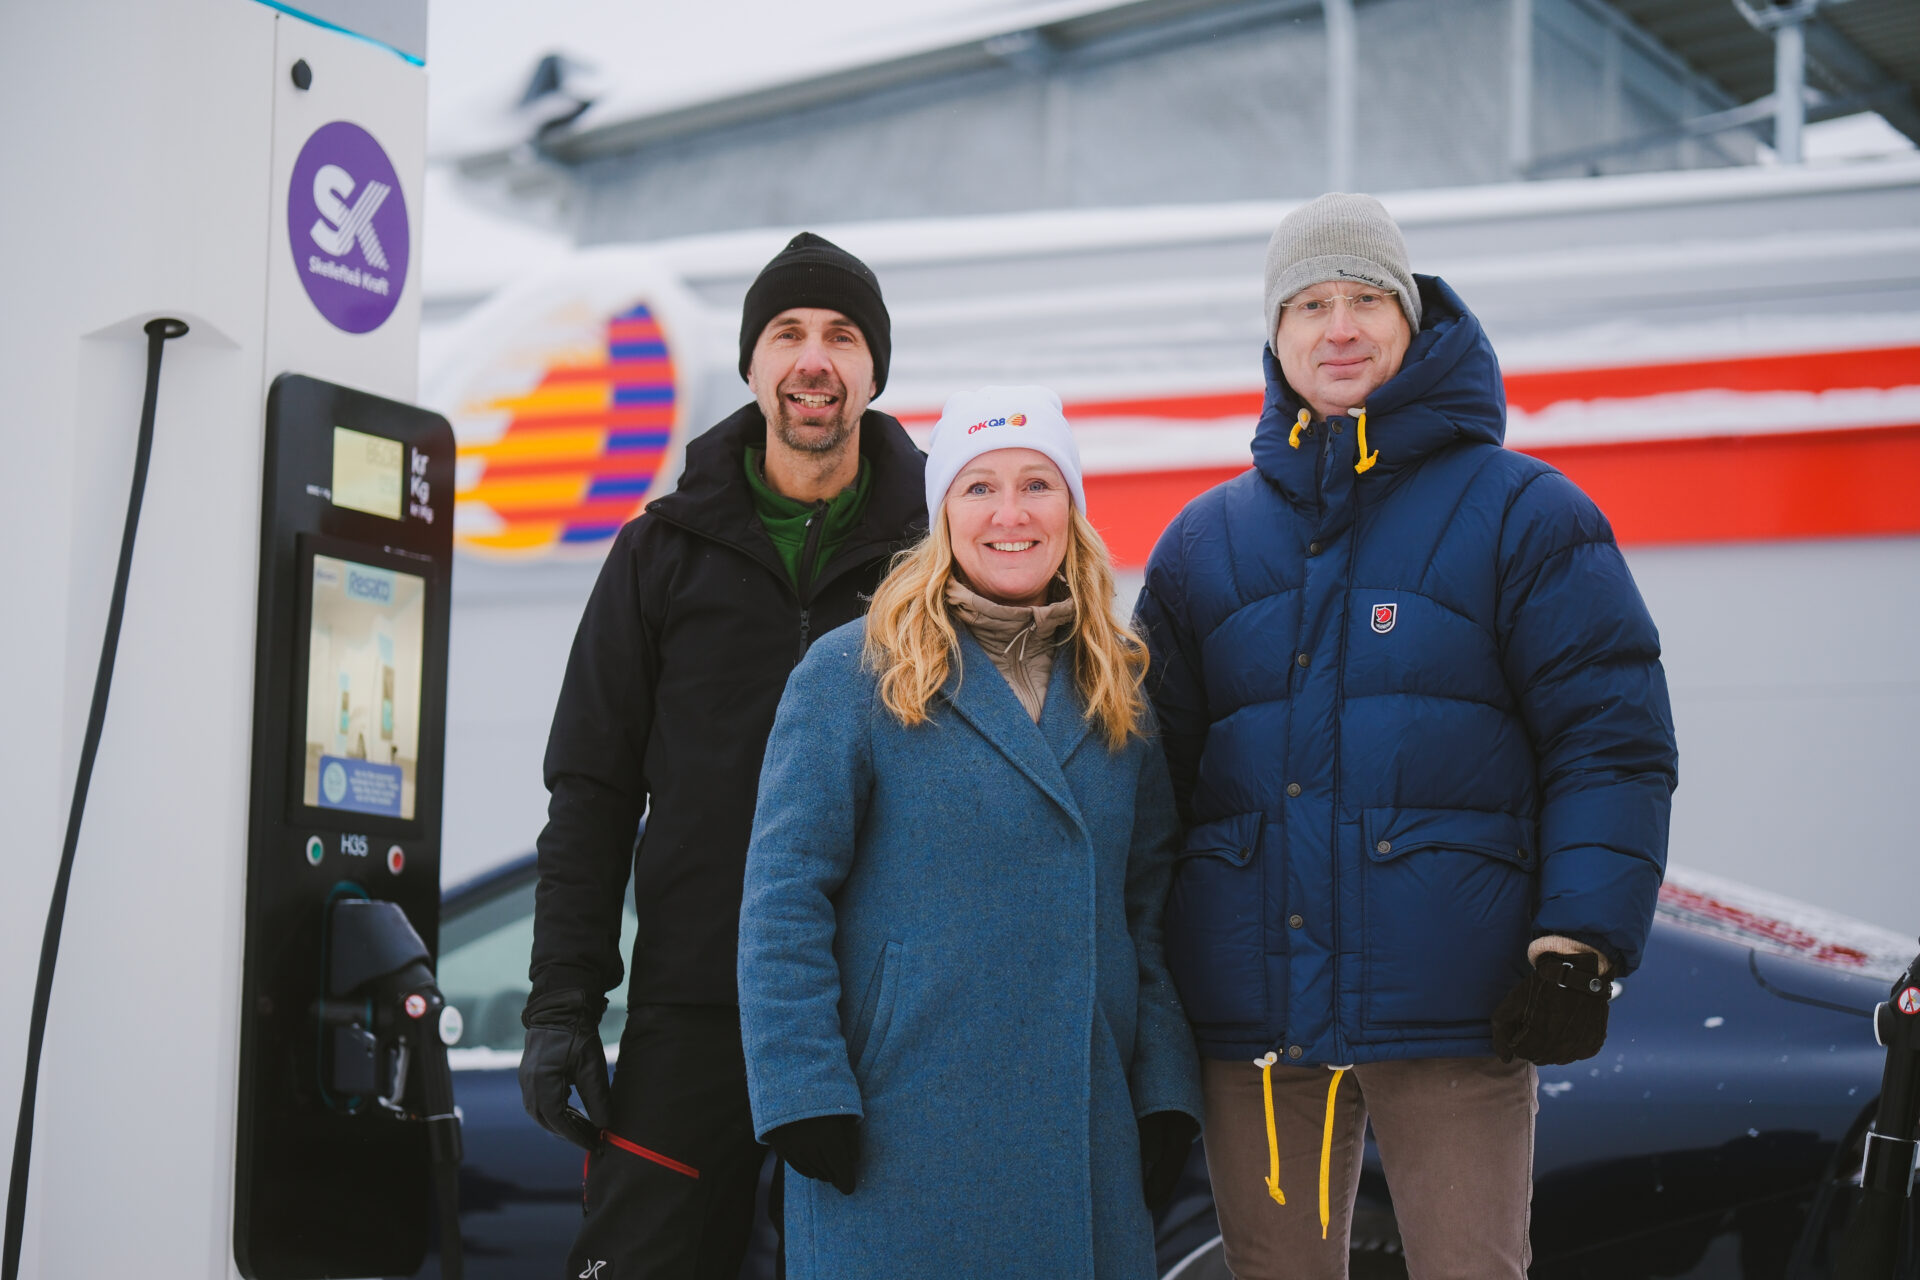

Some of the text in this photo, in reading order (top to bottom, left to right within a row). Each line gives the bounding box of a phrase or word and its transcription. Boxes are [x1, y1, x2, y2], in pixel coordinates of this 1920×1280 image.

[362, 271, 390, 297] Kraft
[411, 446, 430, 477] kr
[410, 473, 430, 505] Kg
[340, 833, 369, 857] H35
